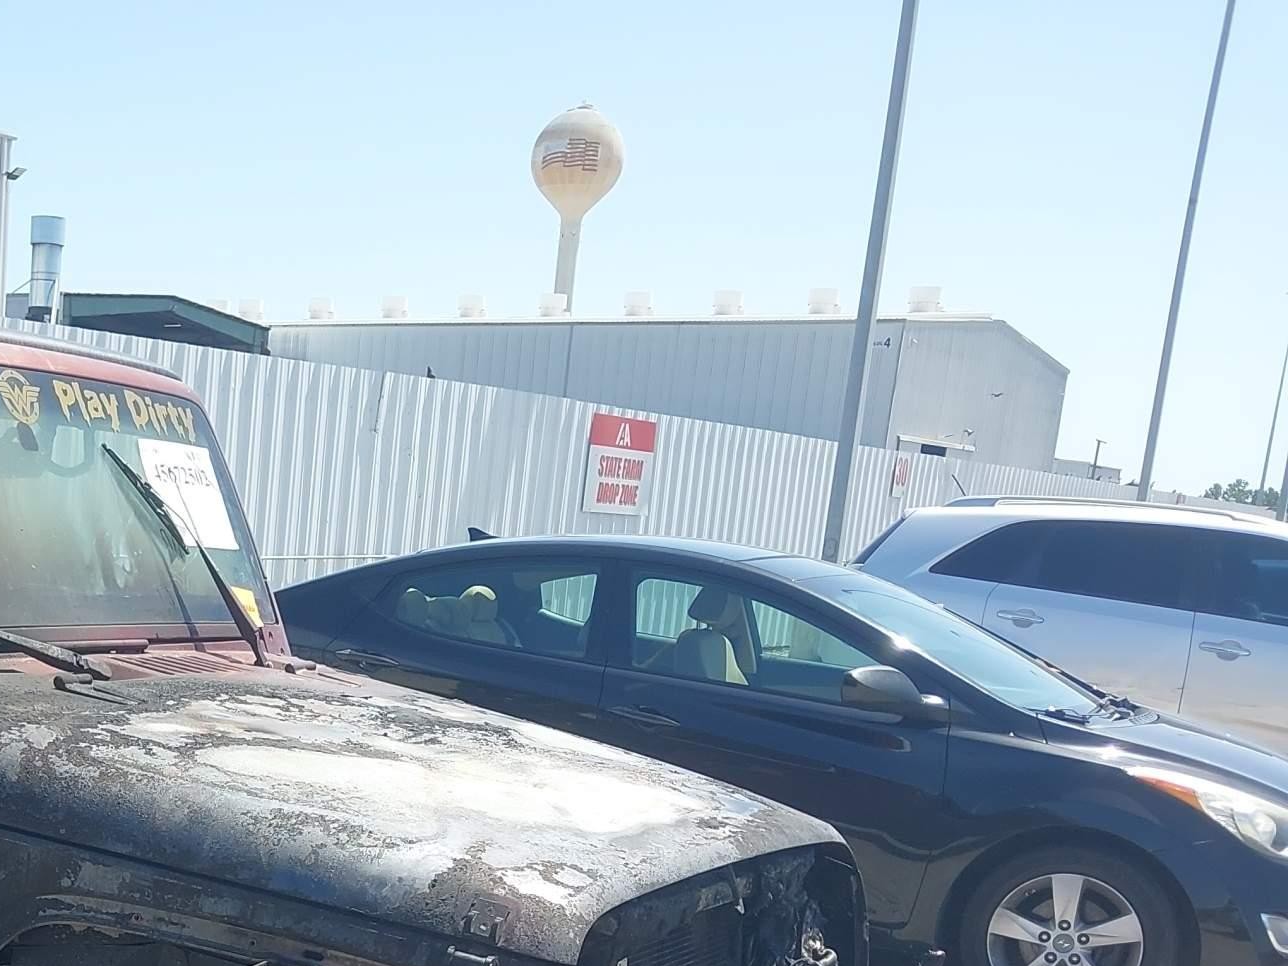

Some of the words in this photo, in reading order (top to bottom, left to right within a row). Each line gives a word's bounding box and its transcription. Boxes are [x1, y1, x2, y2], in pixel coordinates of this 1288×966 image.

[883, 337, 891, 349] 4
[52, 379, 120, 432] Play
[123, 389, 196, 444] Dirty
[598, 455, 622, 479] STATE
[622, 458, 644, 481] FARM
[596, 482, 620, 505] DROP
[619, 485, 639, 506] ZONE
